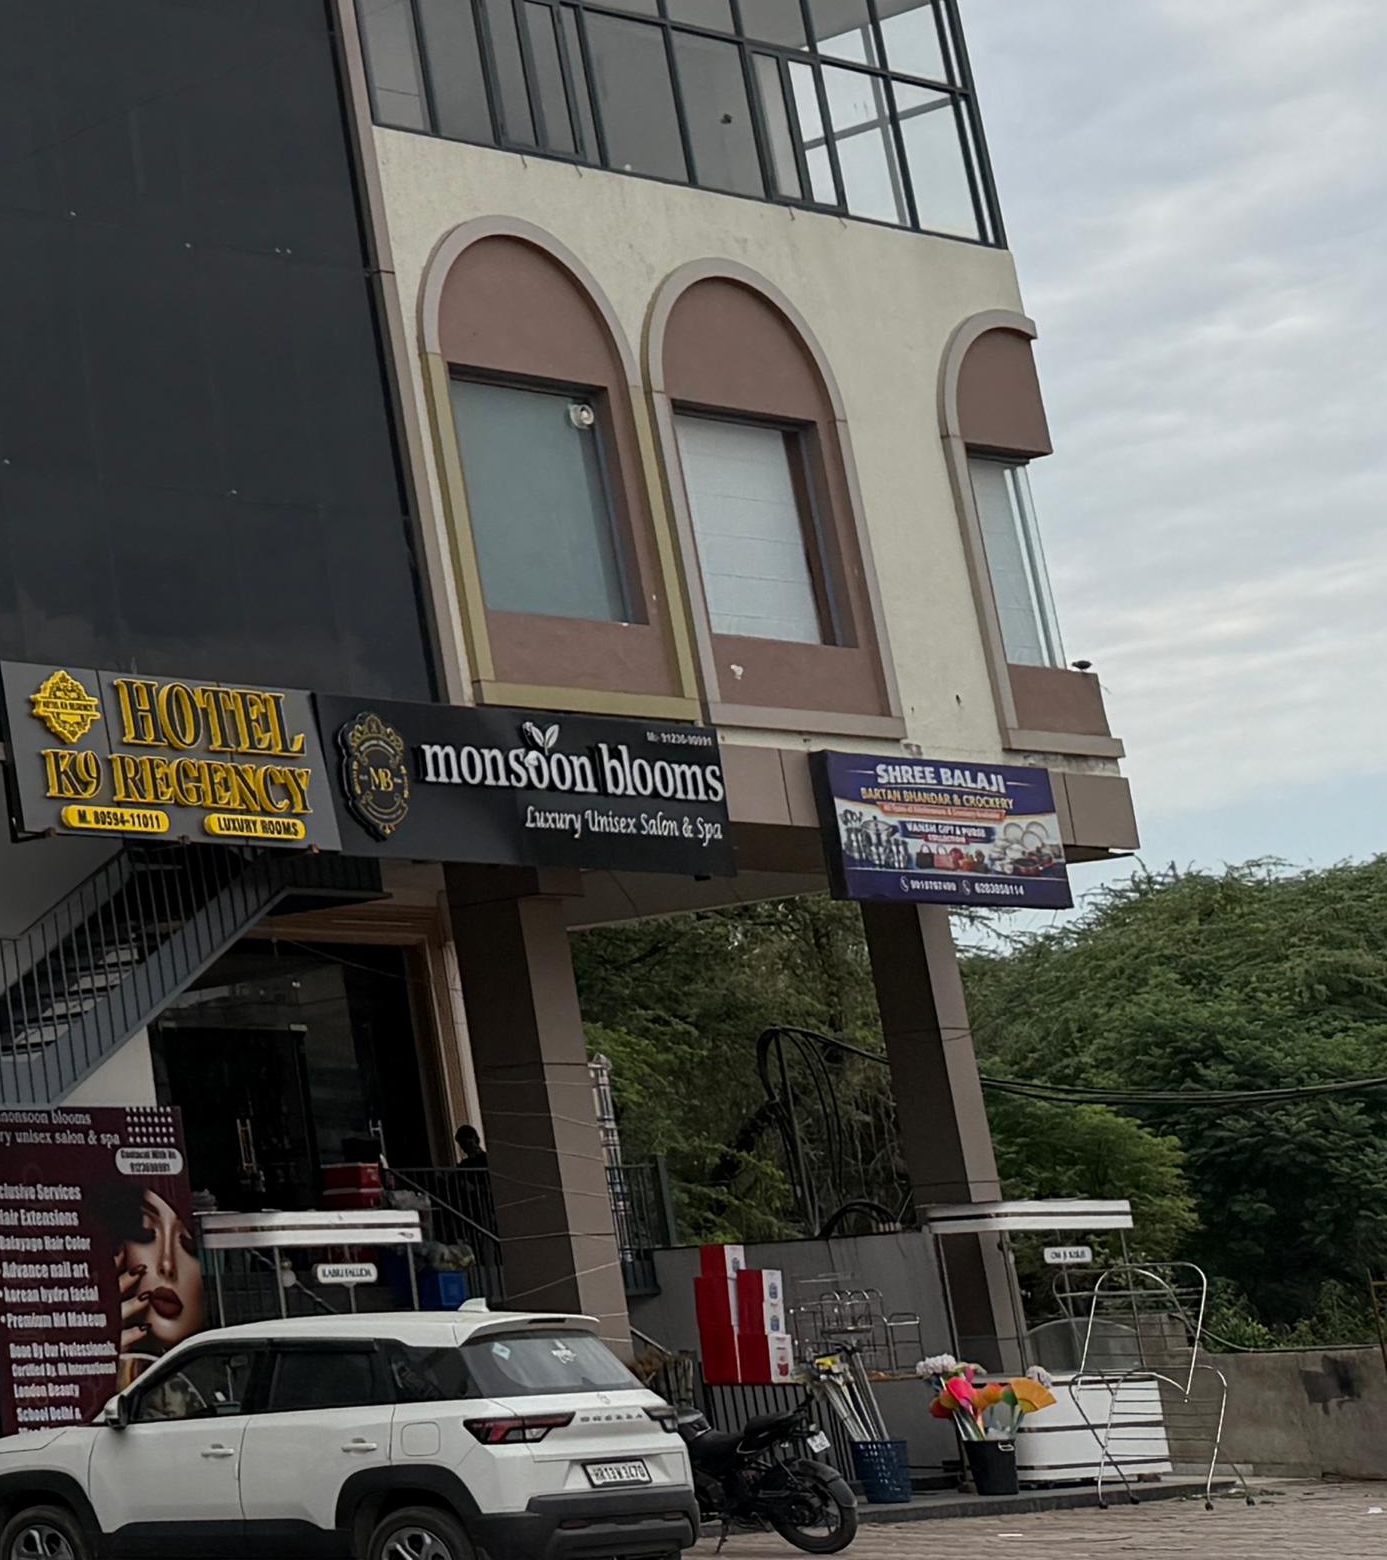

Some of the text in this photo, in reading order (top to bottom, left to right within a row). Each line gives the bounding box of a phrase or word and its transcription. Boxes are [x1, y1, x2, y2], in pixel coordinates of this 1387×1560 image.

[113, 678, 306, 757] HOTEL
[40, 749, 314, 814] K9 REGENCY
[369, 766, 395, 792] MB
[420, 743, 725, 803] monsoon blooms
[876, 764, 1007, 794] SHREE BALAJI
[860, 787, 902, 802] BARTAN
[903, 790, 952, 807] BHANDAR
[962, 795, 1015, 810] CROCKERY
[217, 816, 299, 837] LUXURY ROOMS
[525, 805, 723, 847] Luxury Unisex Salon & Spa
[50, 1109, 92, 1126] blooms
[15, 1128, 53, 1145] unisex
[55, 1130, 85, 1145] salon
[87, 1130, 98, 1145] &
[100, 1133, 121, 1149] spa
[36, 1183, 82, 1201] Services
[20, 1209, 80, 1227] Extensions
[44, 1235, 64, 1251] Hair
[64, 1235, 91, 1251] Color
[2, 1261, 91, 1279] Advance nail art
[6, 1312, 52, 1328] Premium
[13, 1382, 80, 1399] London Beauty
[16, 1406, 49, 1422] School
[49, 1405, 74, 1421] Delhi
